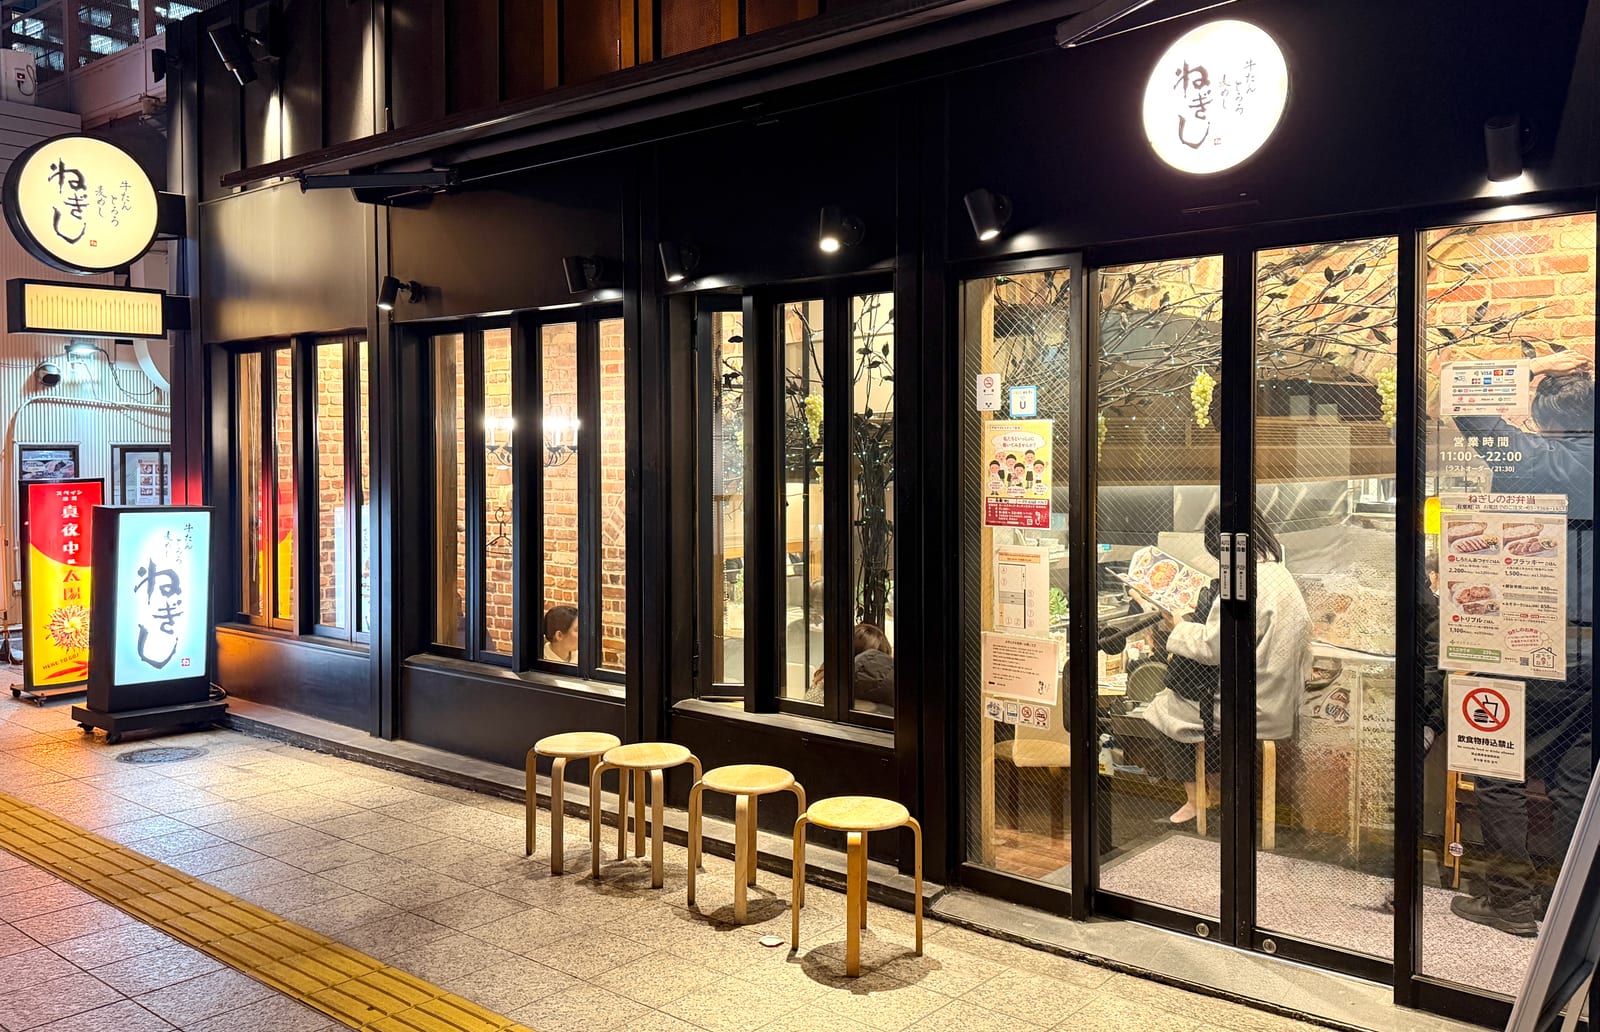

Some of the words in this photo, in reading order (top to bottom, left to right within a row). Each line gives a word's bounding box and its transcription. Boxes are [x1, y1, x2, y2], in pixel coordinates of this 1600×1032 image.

[1173, 59, 1214, 150] ねぎし
[47, 157, 90, 245] ねぎし
[119, 180, 133, 212] 牛たん
[1453, 436, 1509, 448] 営業時間
[1468, 494, 1536, 505] ねぎしのお弁当
[134, 557, 184, 670] ねぎし
[1457, 734, 1515, 750] 飲食物持込禁止
